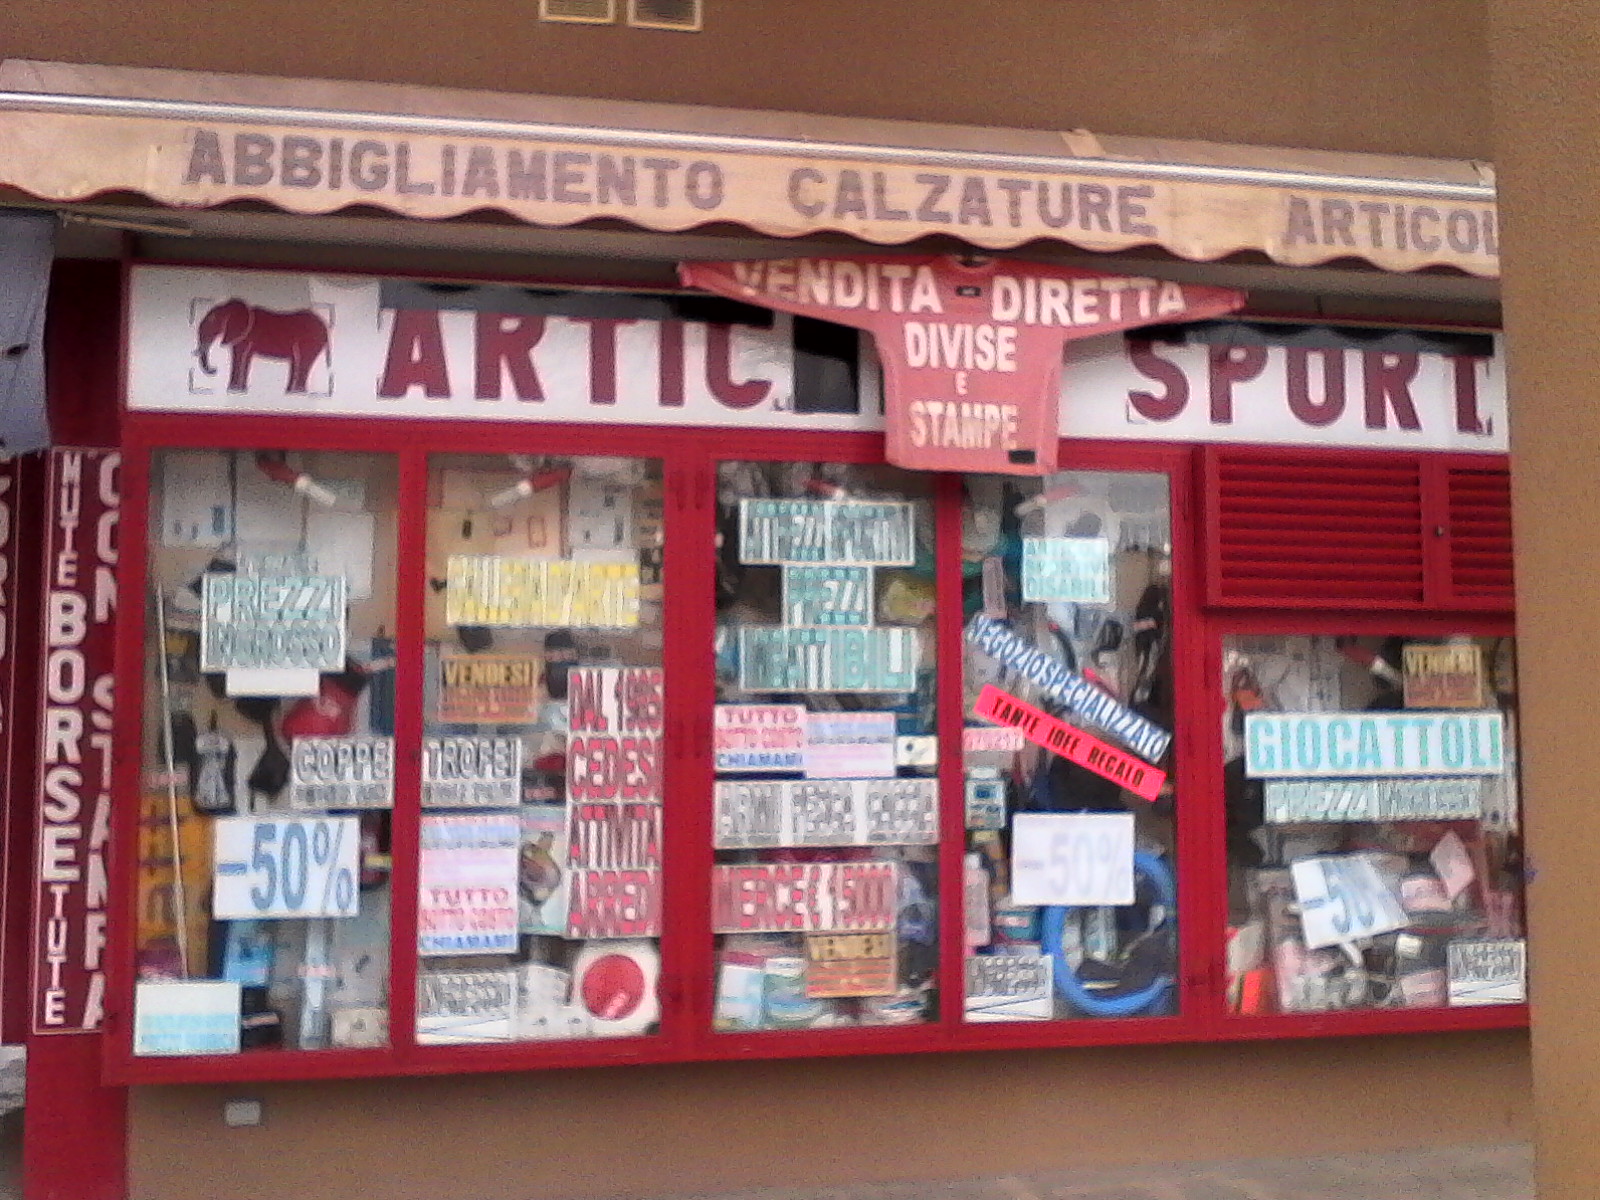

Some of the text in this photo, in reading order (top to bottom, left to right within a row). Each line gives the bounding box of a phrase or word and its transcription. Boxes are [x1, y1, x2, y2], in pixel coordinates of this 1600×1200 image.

[184, 129, 724, 210] ABBIGLIAMENTO
[787, 168, 1159, 237] CALZATURE
[732, 262, 1187, 327] VENDITA DIRETTA
[903, 321, 1018, 372] DIVISE
[955, 371, 968, 395] E
[908, 401, 1018, 450] STAMPE
[207, 575, 342, 621] PREZZI
[787, 566, 865, 626] PREZZI
[445, 660, 531, 687] VENDESI
[43, 589, 87, 882] BORSE
[725, 706, 799, 723] TUTTO
[295, 738, 391, 782] COPPE
[423, 738, 517, 779] TROFEI
[567, 736, 662, 798] CEDESI
[993, 698, 1041, 736] TANTE
[1046, 726, 1081, 756] IDEE
[1087, 745, 1145, 788] REGALO
[1249, 718, 1500, 769] GIOCATTOLI
[217, 822, 352, 910] -50%
[1016, 832, 1127, 897] -50%
[431, 886, 509, 906] TUTTO
[568, 870, 661, 936] ARREDI
